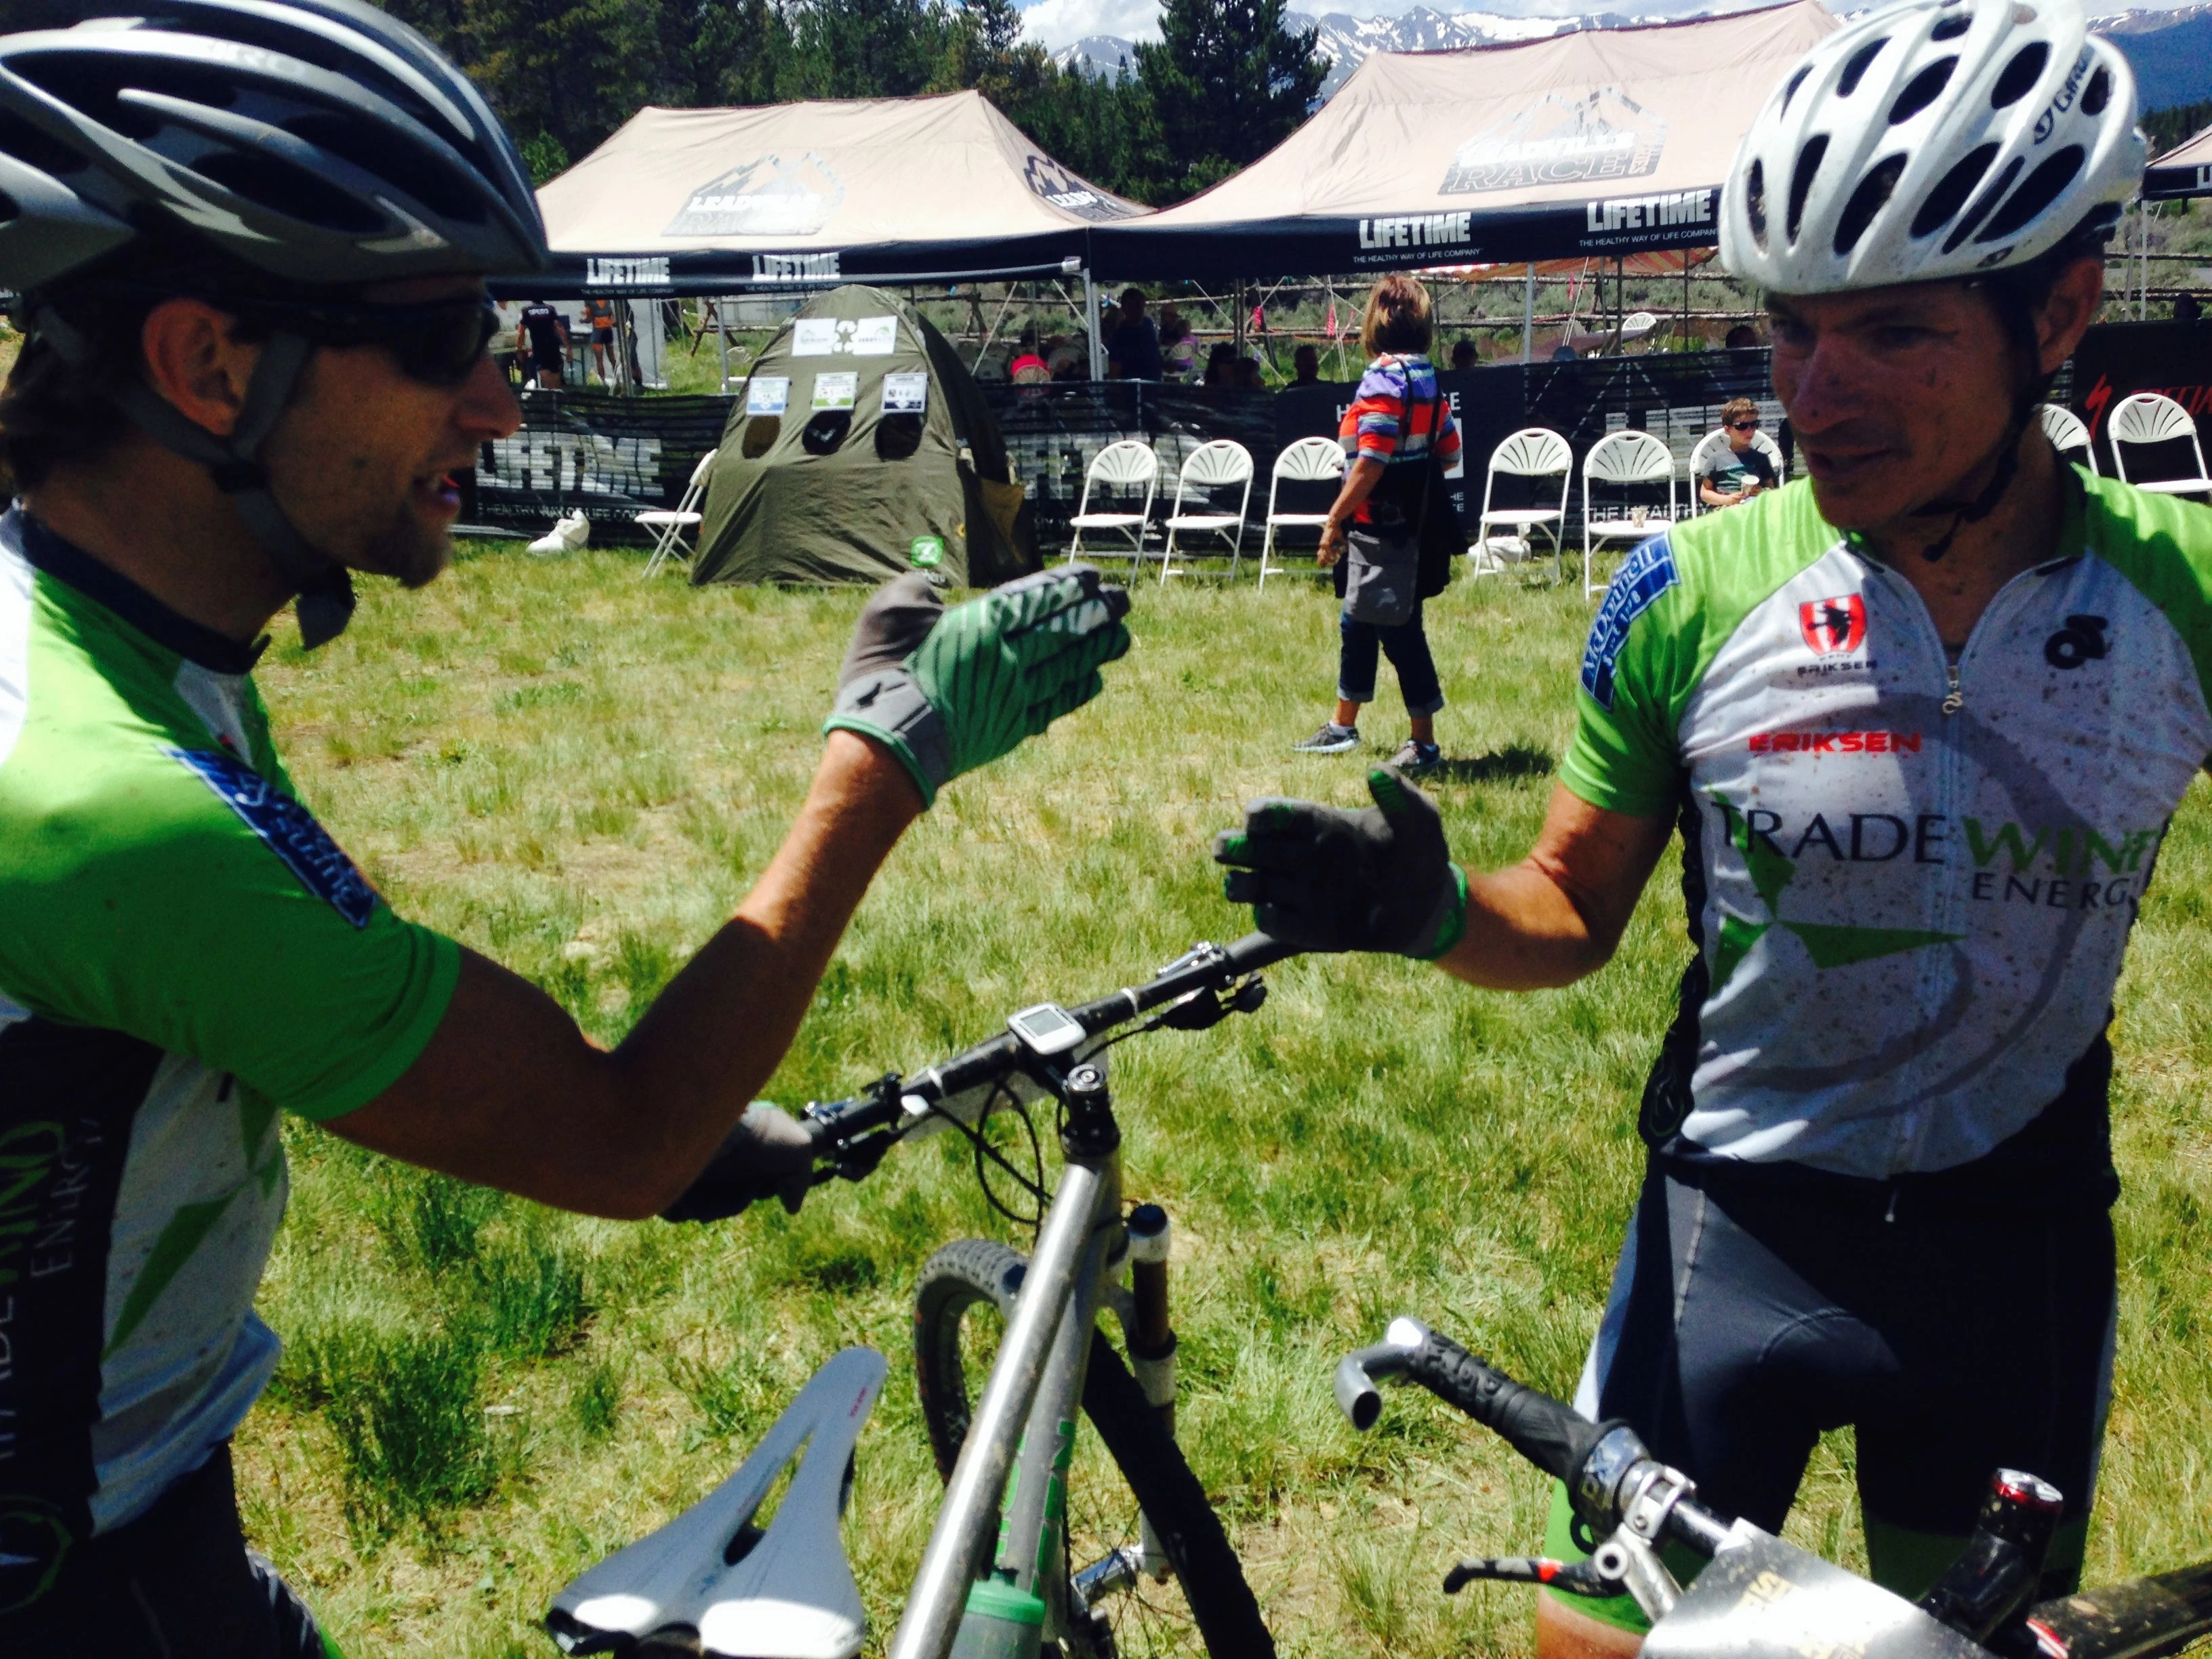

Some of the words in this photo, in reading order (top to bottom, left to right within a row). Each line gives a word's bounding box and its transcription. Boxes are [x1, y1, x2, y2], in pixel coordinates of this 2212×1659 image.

[1448, 147, 1631, 192] RACE
[1587, 189, 1712, 232] LIFETIME
[1359, 211, 1471, 249] LIFETIME
[1596, 237, 1630, 245] HEALTHY
[1632, 235, 1648, 243] WAY
[1663, 232, 1679, 240] LIFE
[752, 252, 841, 282] LIFETIME
[1368, 253, 1398, 262] HEALTHY
[1417, 251, 1426, 260] OF
[1428, 251, 1442, 259] LIFE
[1444, 249, 1480, 257] COMPANY
[586, 257, 671, 285] LIFETIME
[476, 432, 664, 496] LIFETIME
[1748, 731, 1923, 754] ERIKSEN
